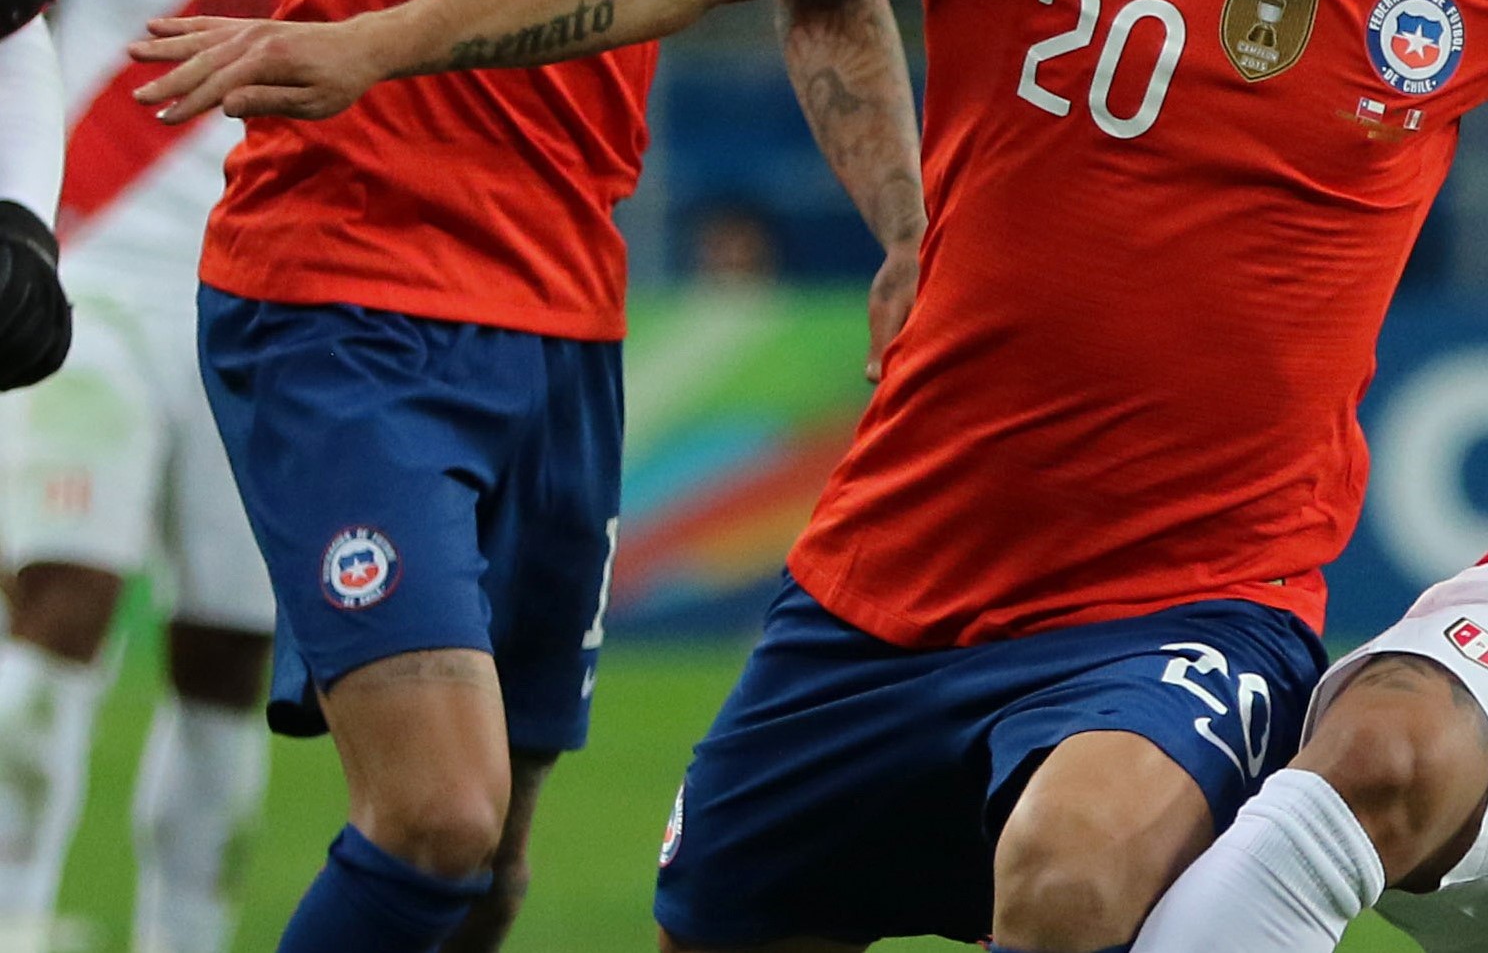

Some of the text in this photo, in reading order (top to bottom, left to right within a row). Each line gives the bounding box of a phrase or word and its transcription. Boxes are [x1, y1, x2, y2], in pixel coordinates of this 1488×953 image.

[1446, 6, 1464, 52] FUTBOL
[1383, 68, 1433, 94] DE CHILE
[1159, 642, 1272, 779] 20
